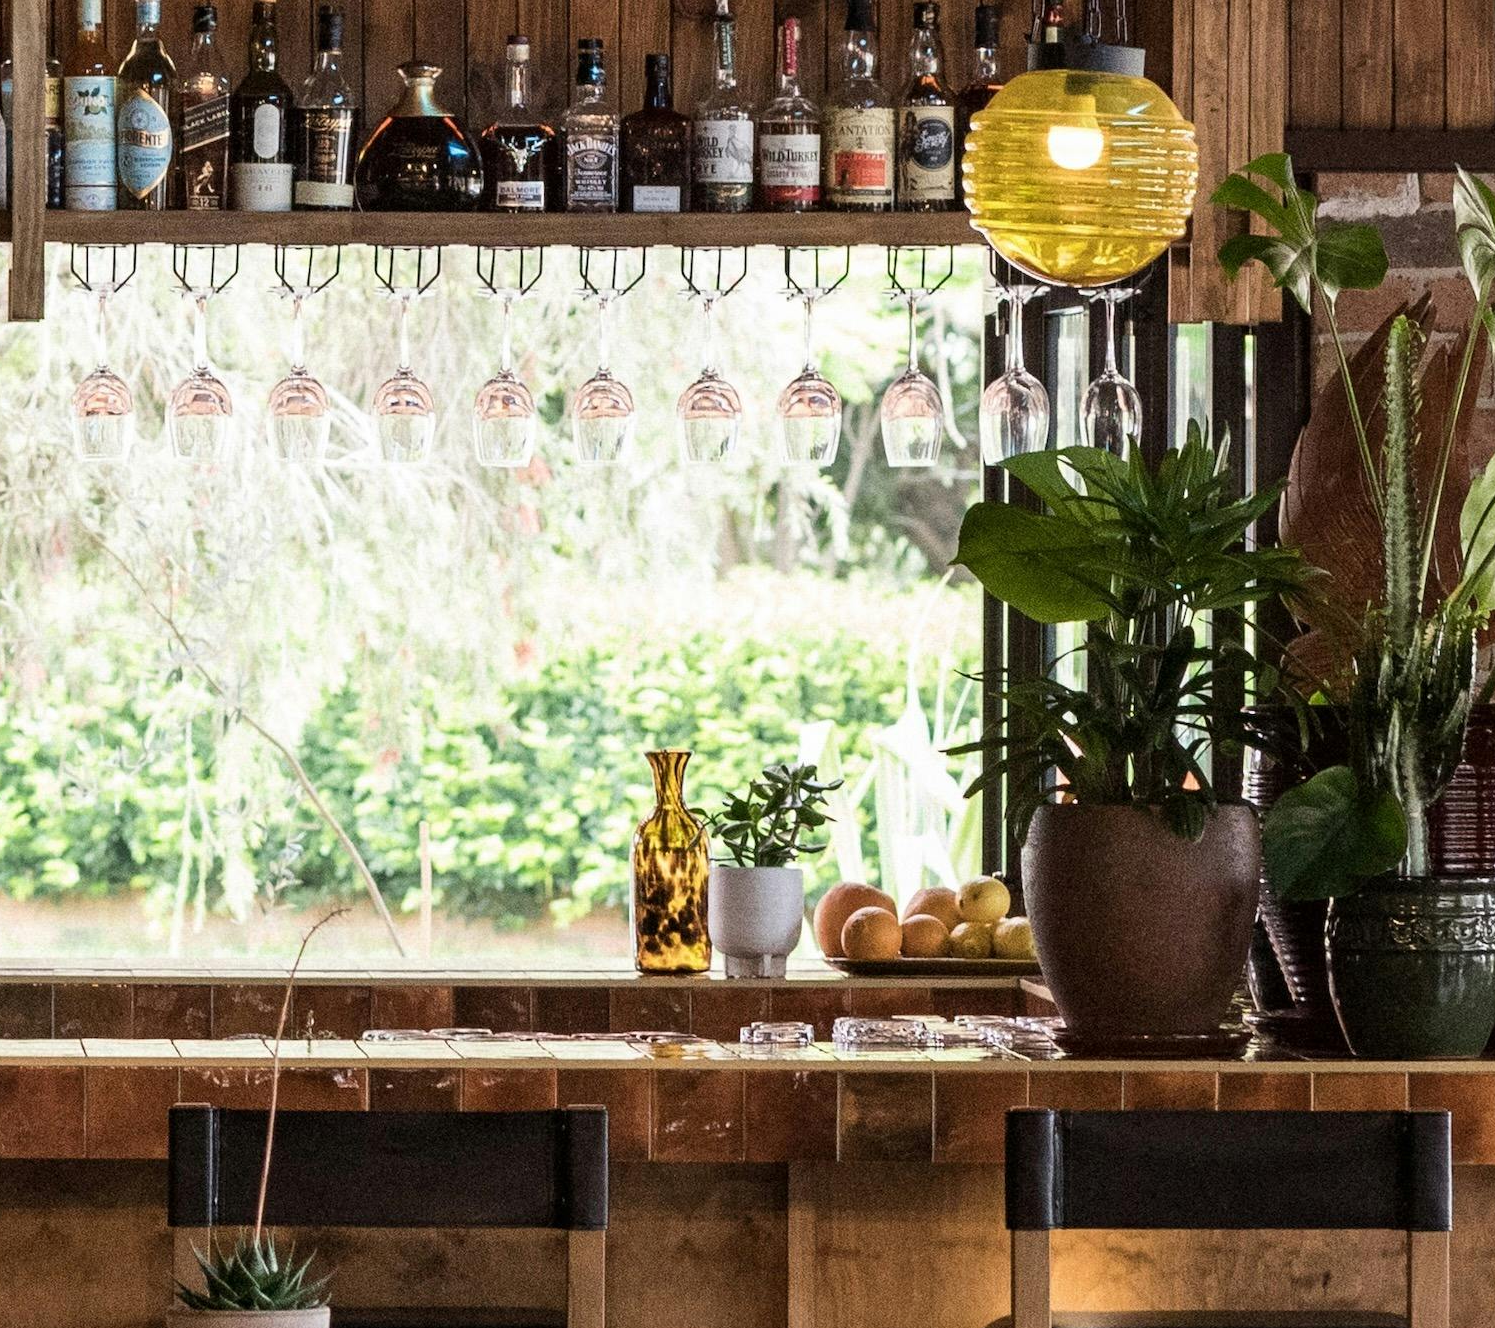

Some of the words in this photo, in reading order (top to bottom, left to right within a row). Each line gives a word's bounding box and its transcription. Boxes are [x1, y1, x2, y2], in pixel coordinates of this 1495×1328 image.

[207, 109, 231, 124] LABEL
[830, 126, 892, 137] ANTATION
[696, 136, 719, 148] WILD
[566, 142, 587, 157] JACK
[762, 150, 787, 163] WILD
[786, 148, 819, 162] TURKEY
[199, 197, 211, 207] 12
